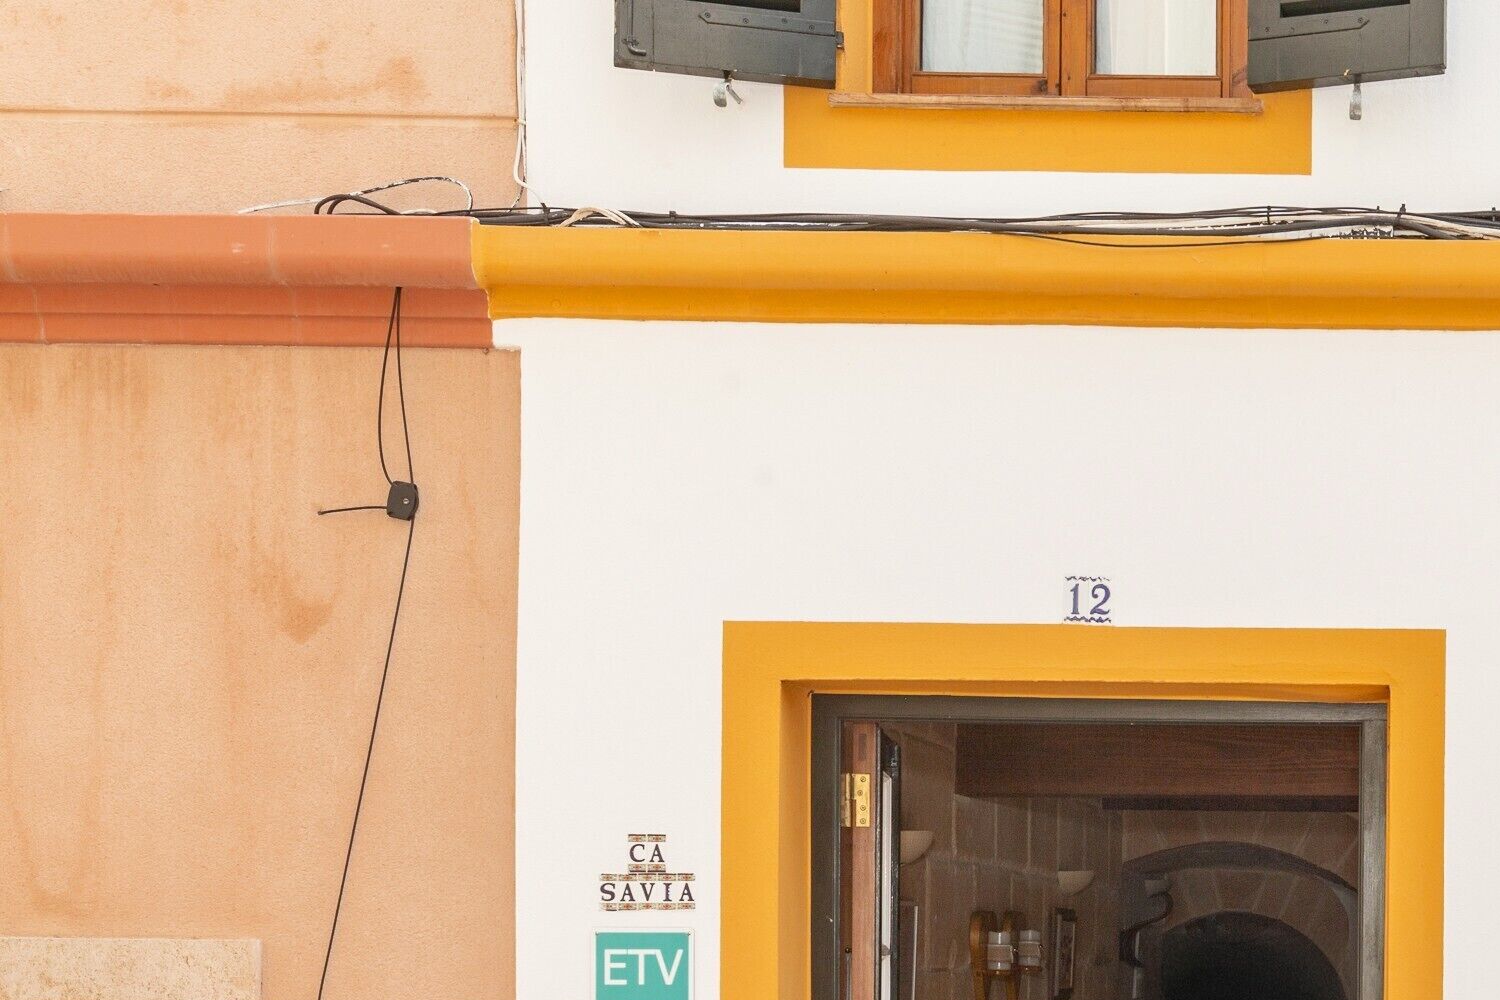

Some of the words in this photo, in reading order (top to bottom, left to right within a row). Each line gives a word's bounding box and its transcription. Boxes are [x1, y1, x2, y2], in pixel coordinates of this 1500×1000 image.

[1070, 583, 1111, 615] 12
[629, 843, 665, 863] CA
[600, 882, 695, 902] SAVIA
[604, 949, 683, 986] ETV
